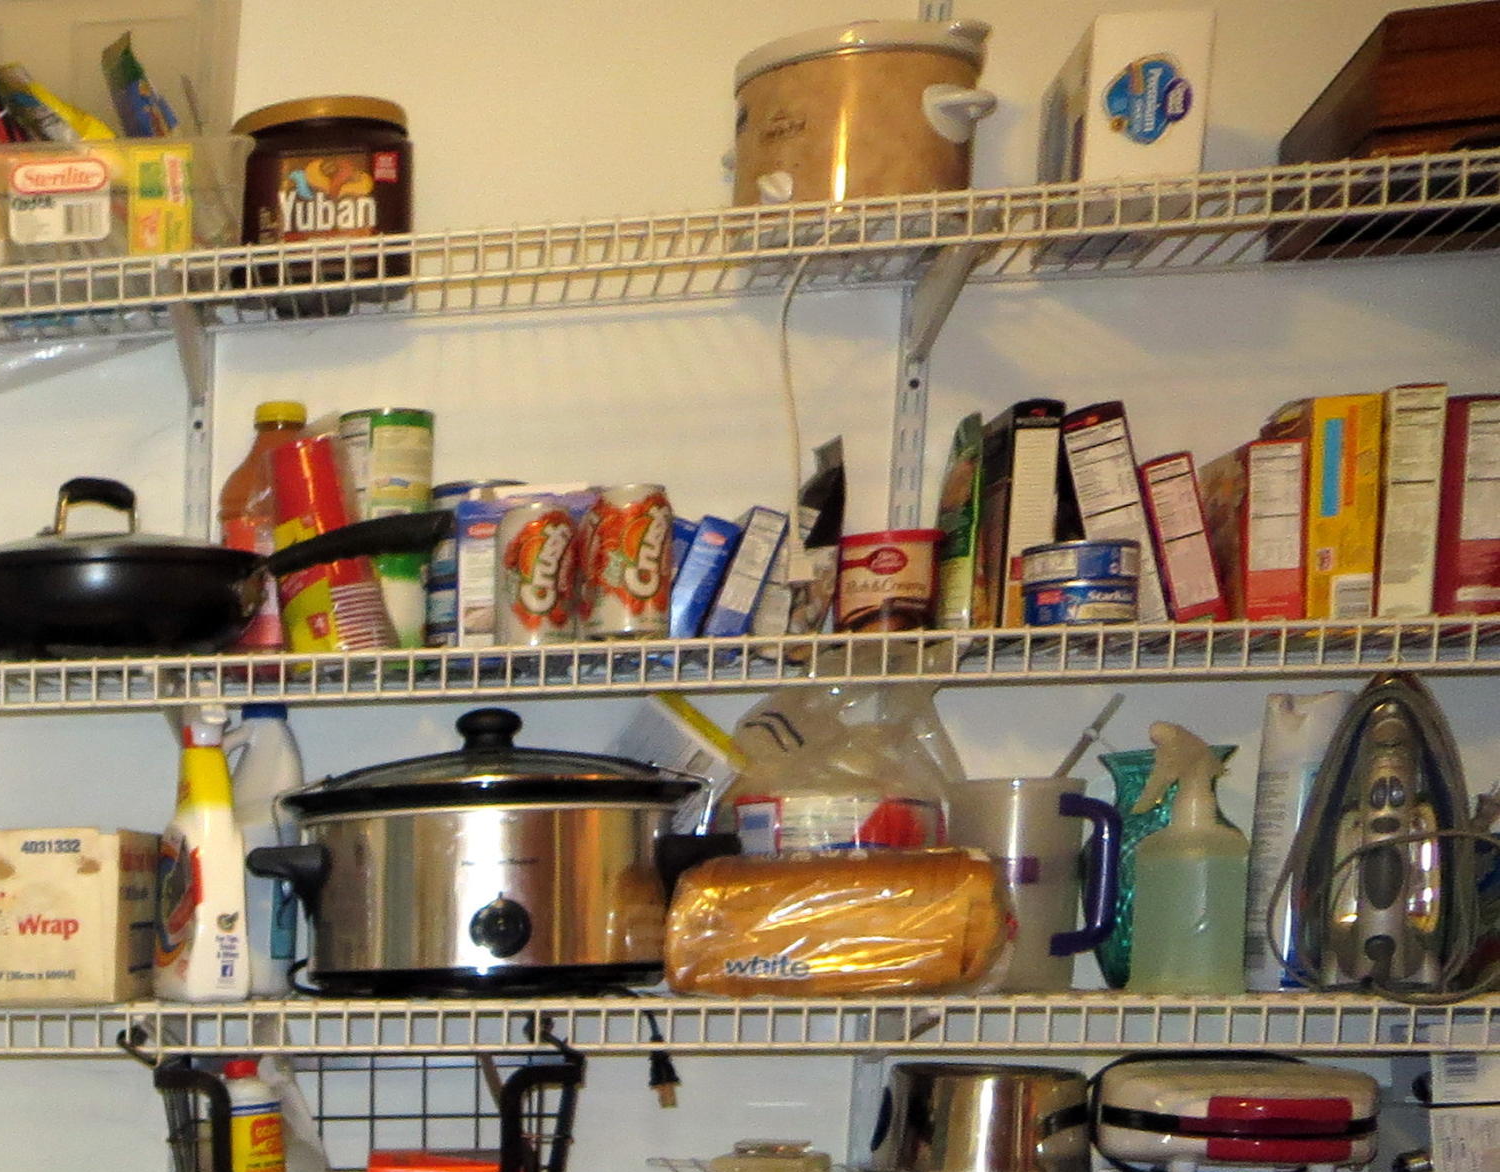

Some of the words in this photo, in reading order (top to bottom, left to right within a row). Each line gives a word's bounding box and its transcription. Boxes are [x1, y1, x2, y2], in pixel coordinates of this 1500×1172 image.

[278, 191, 377, 232] Yuban
[623, 502, 672, 599] Crush
[21, 839, 82, 854] 4031332
[18, 914, 80, 941] Wrap
[725, 955, 810, 977] white
